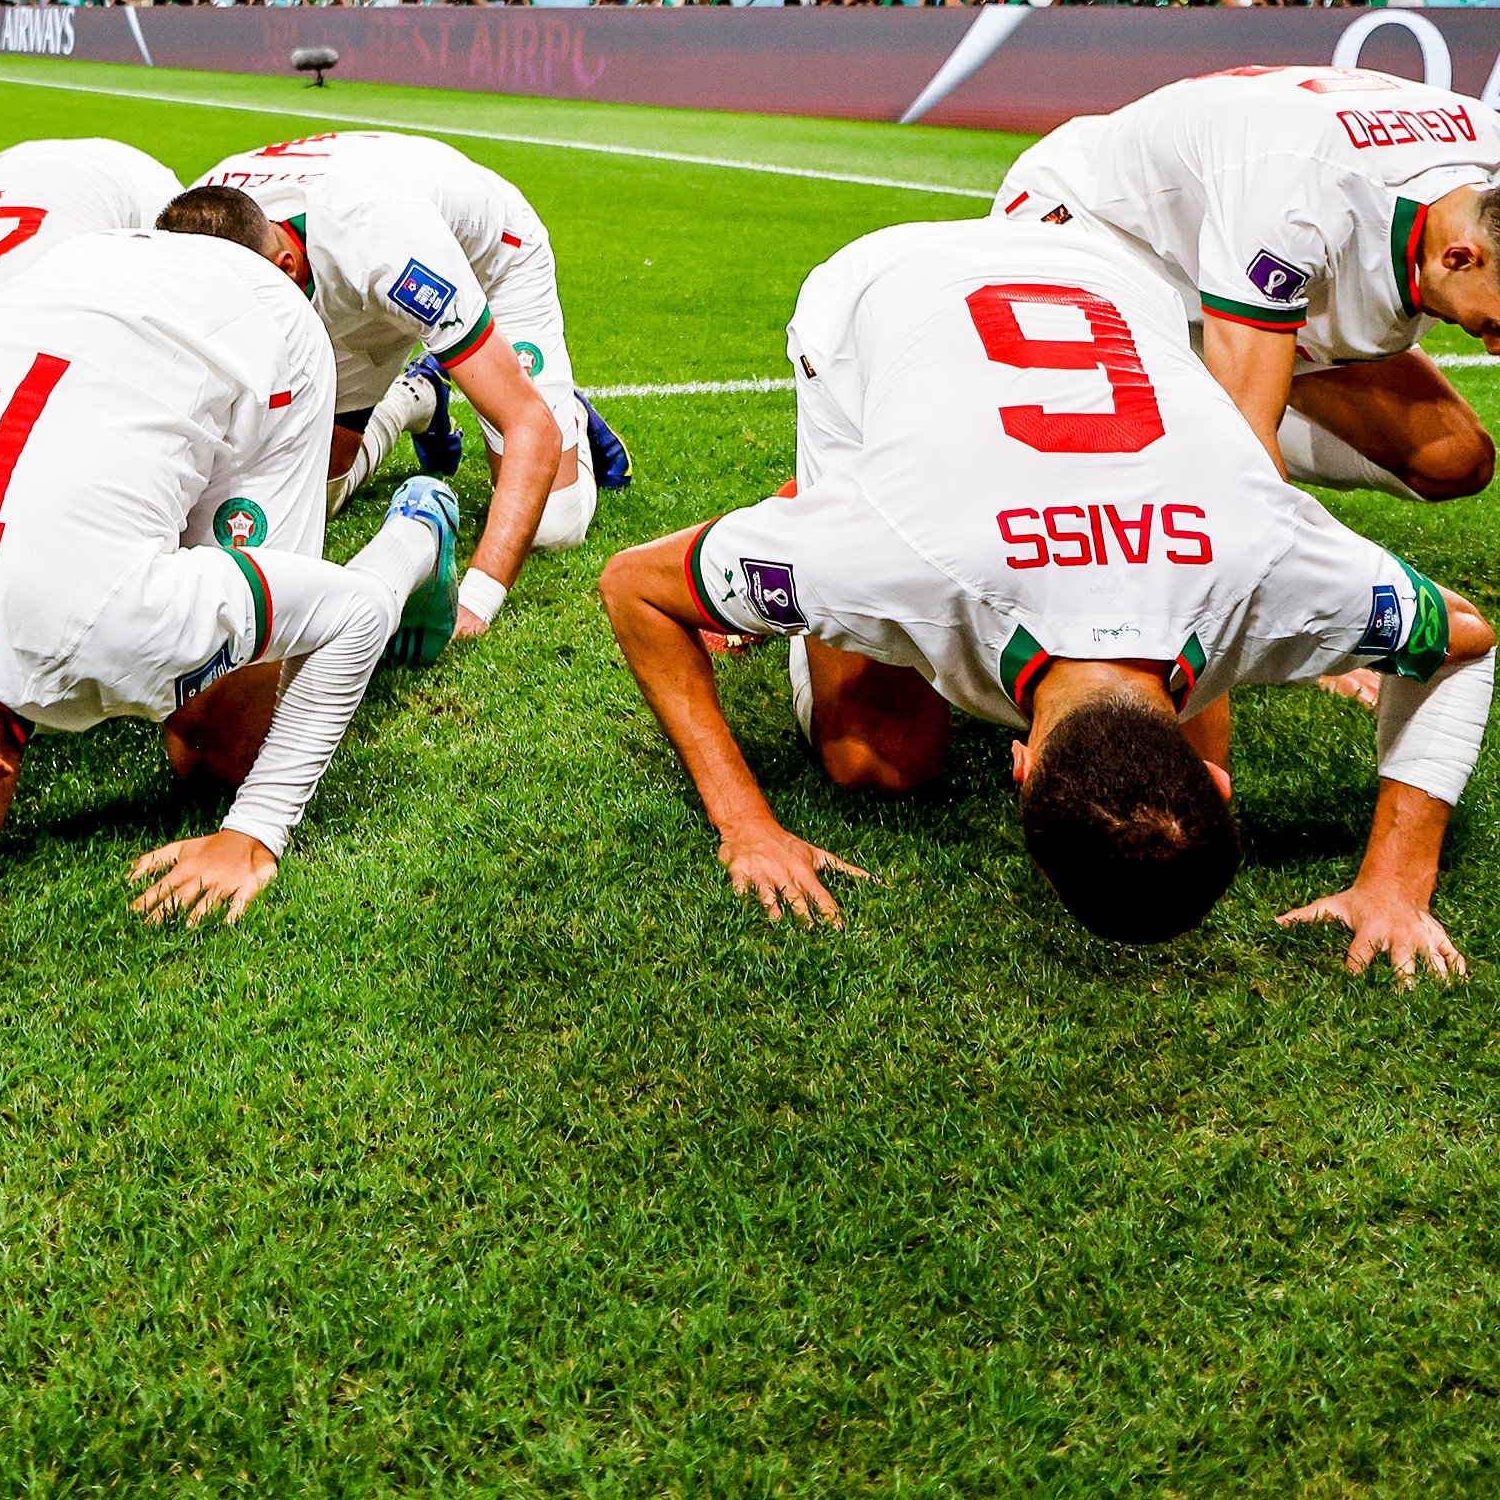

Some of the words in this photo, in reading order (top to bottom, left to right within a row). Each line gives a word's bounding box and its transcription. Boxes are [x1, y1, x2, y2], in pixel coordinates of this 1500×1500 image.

[2, 6, 76, 55] AIRWAYS
[964, 284, 1166, 454] 6
[995, 503, 1214, 571] SAISS
